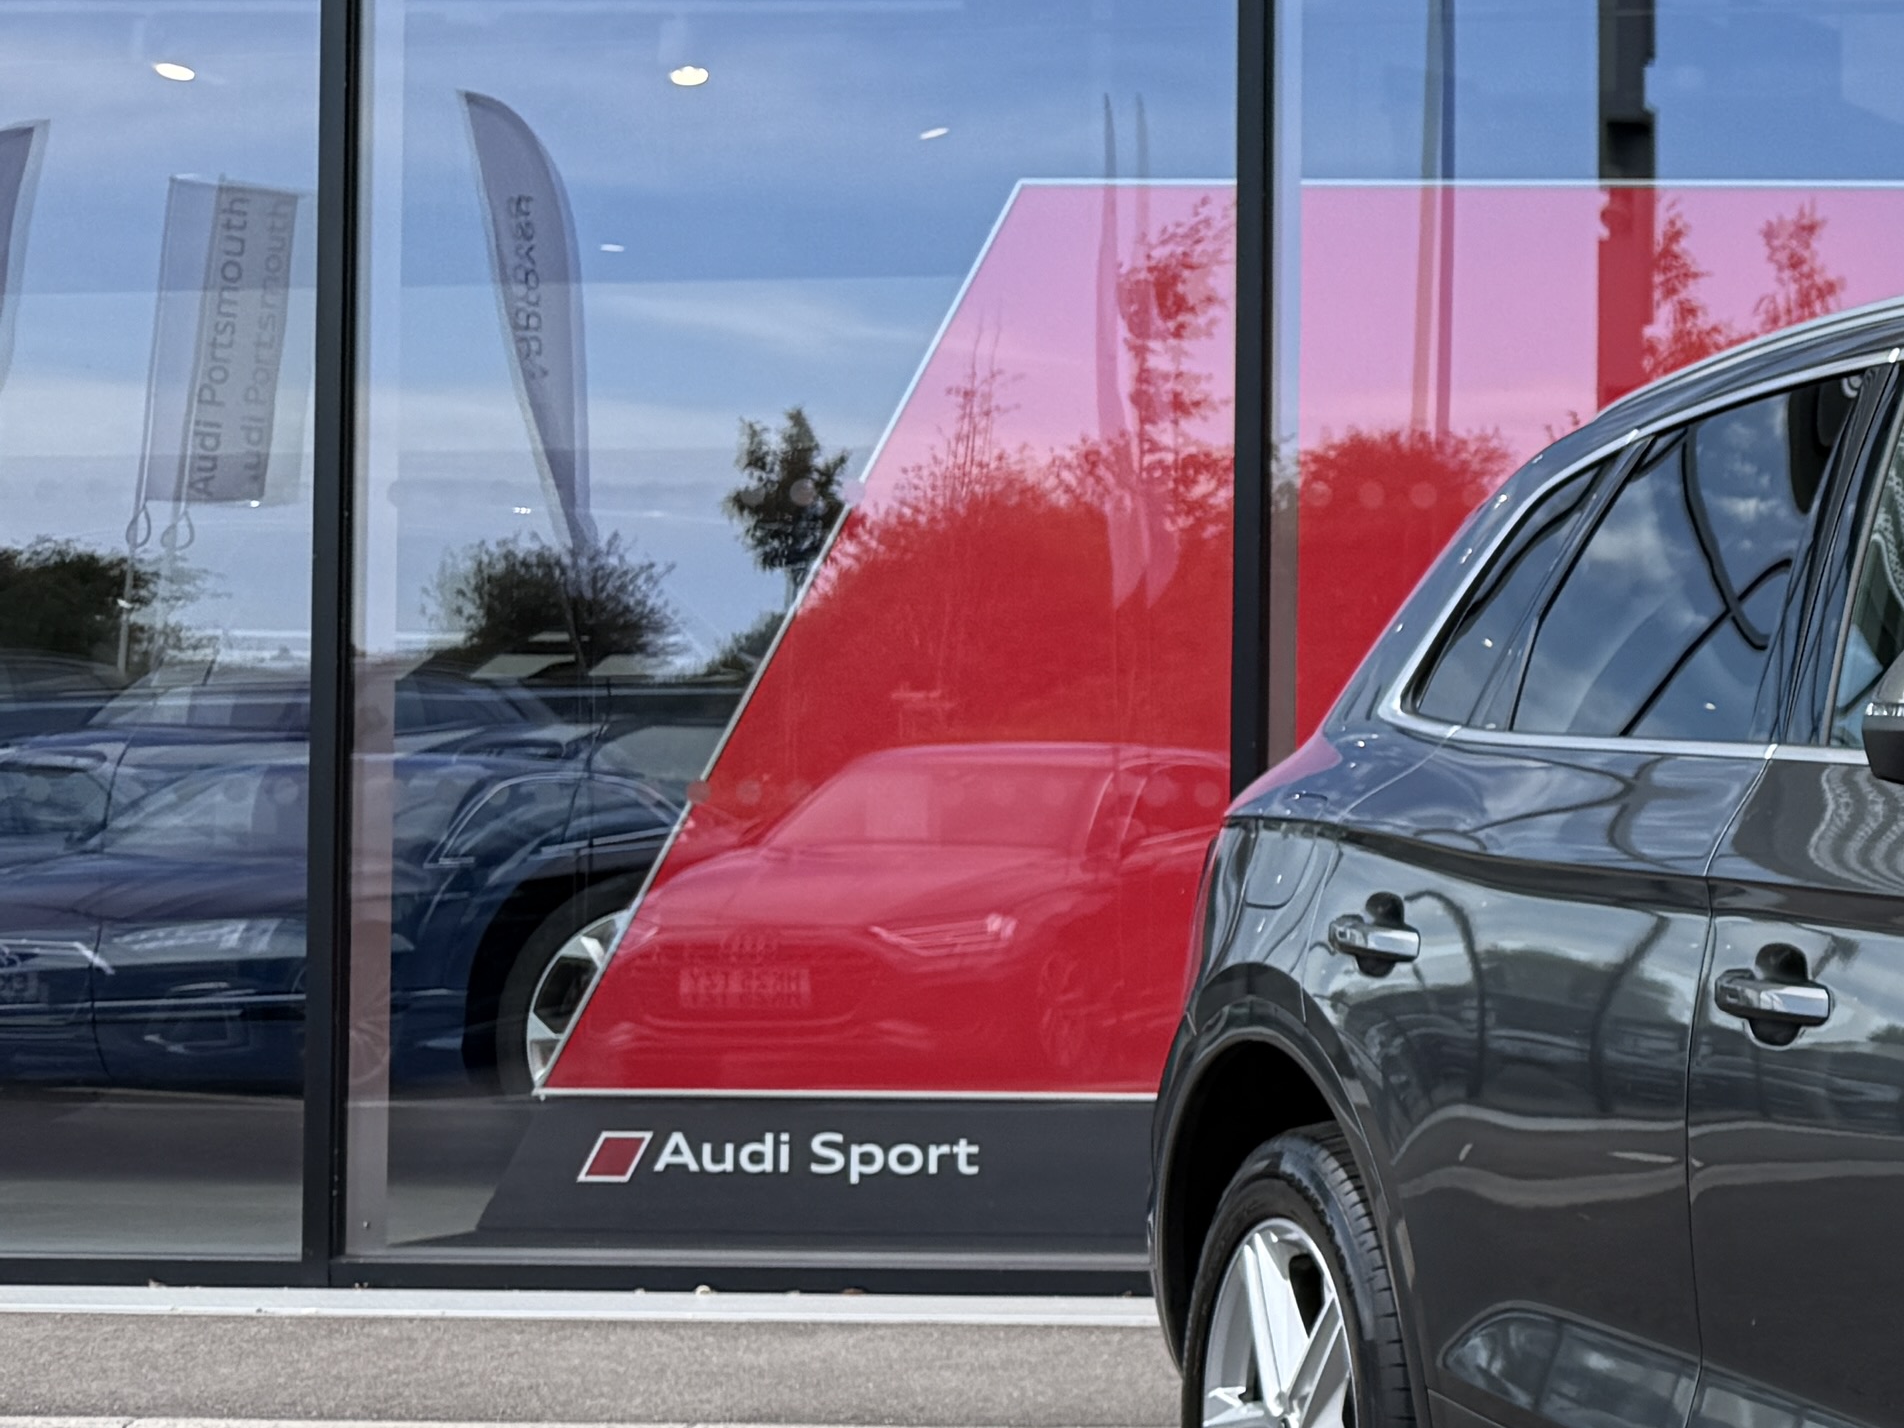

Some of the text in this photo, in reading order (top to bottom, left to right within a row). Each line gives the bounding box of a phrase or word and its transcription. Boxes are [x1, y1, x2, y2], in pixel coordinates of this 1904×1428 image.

[187, 196, 250, 497] Audi Portsmouth
[653, 1131, 980, 1185] Audi Sport
